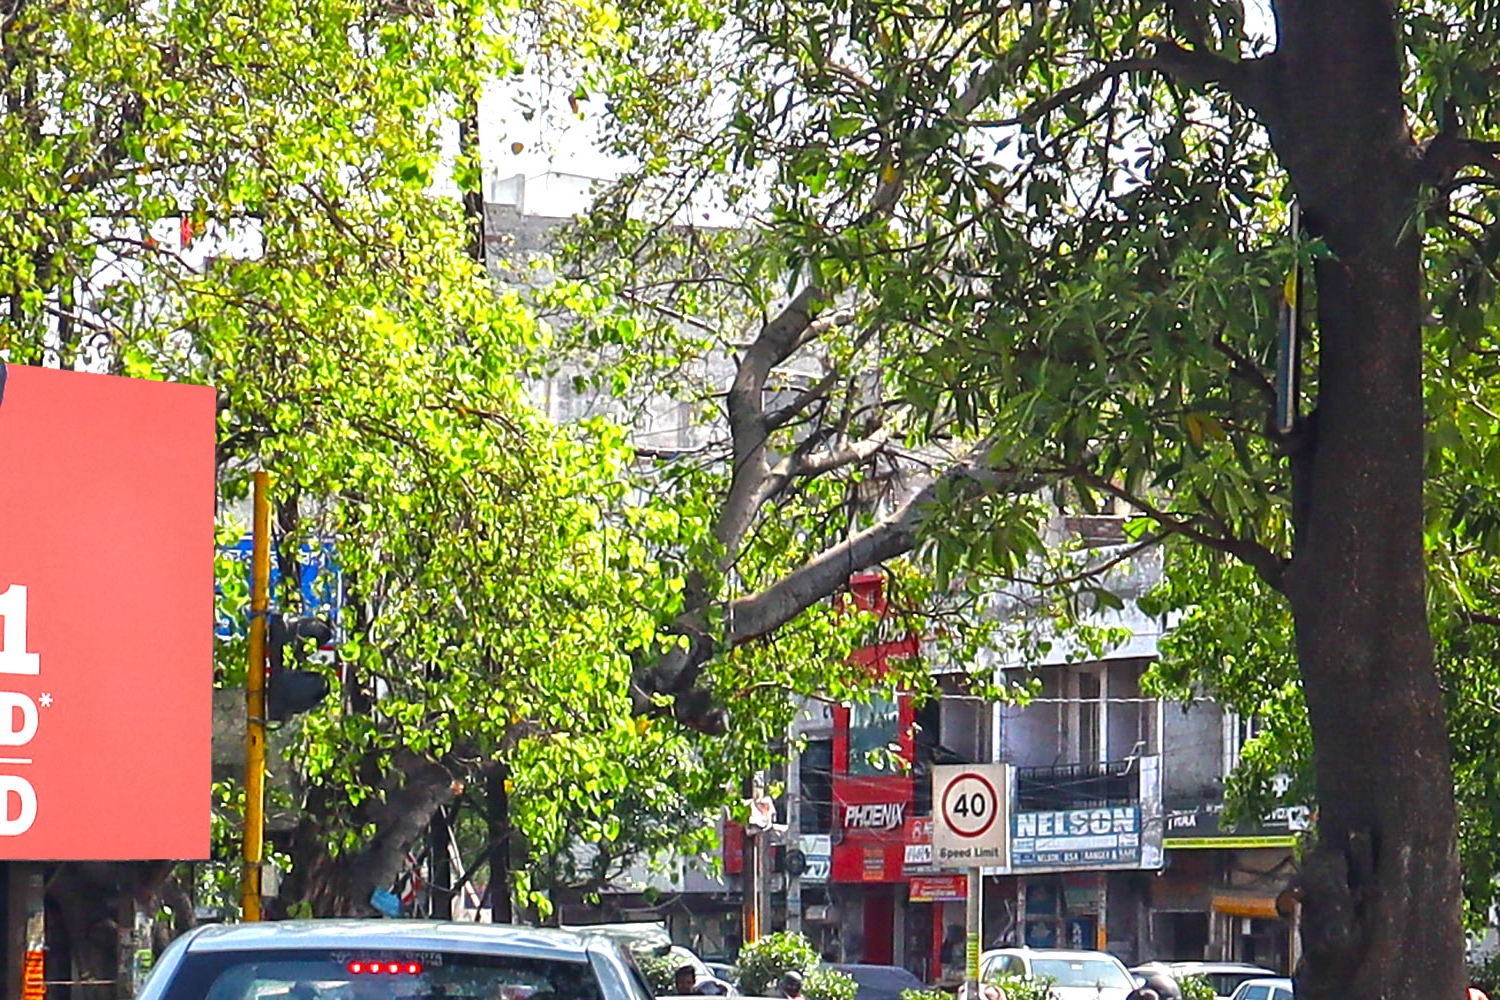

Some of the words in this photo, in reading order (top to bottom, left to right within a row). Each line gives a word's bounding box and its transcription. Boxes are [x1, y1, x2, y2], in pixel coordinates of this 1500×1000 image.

[844, 801, 907, 830] PHOENIX
[953, 793, 986, 818] 40
[1017, 808, 1135, 837] NELSON
[940, 847, 971, 859] Speed
[974, 847, 999, 858] Limit
